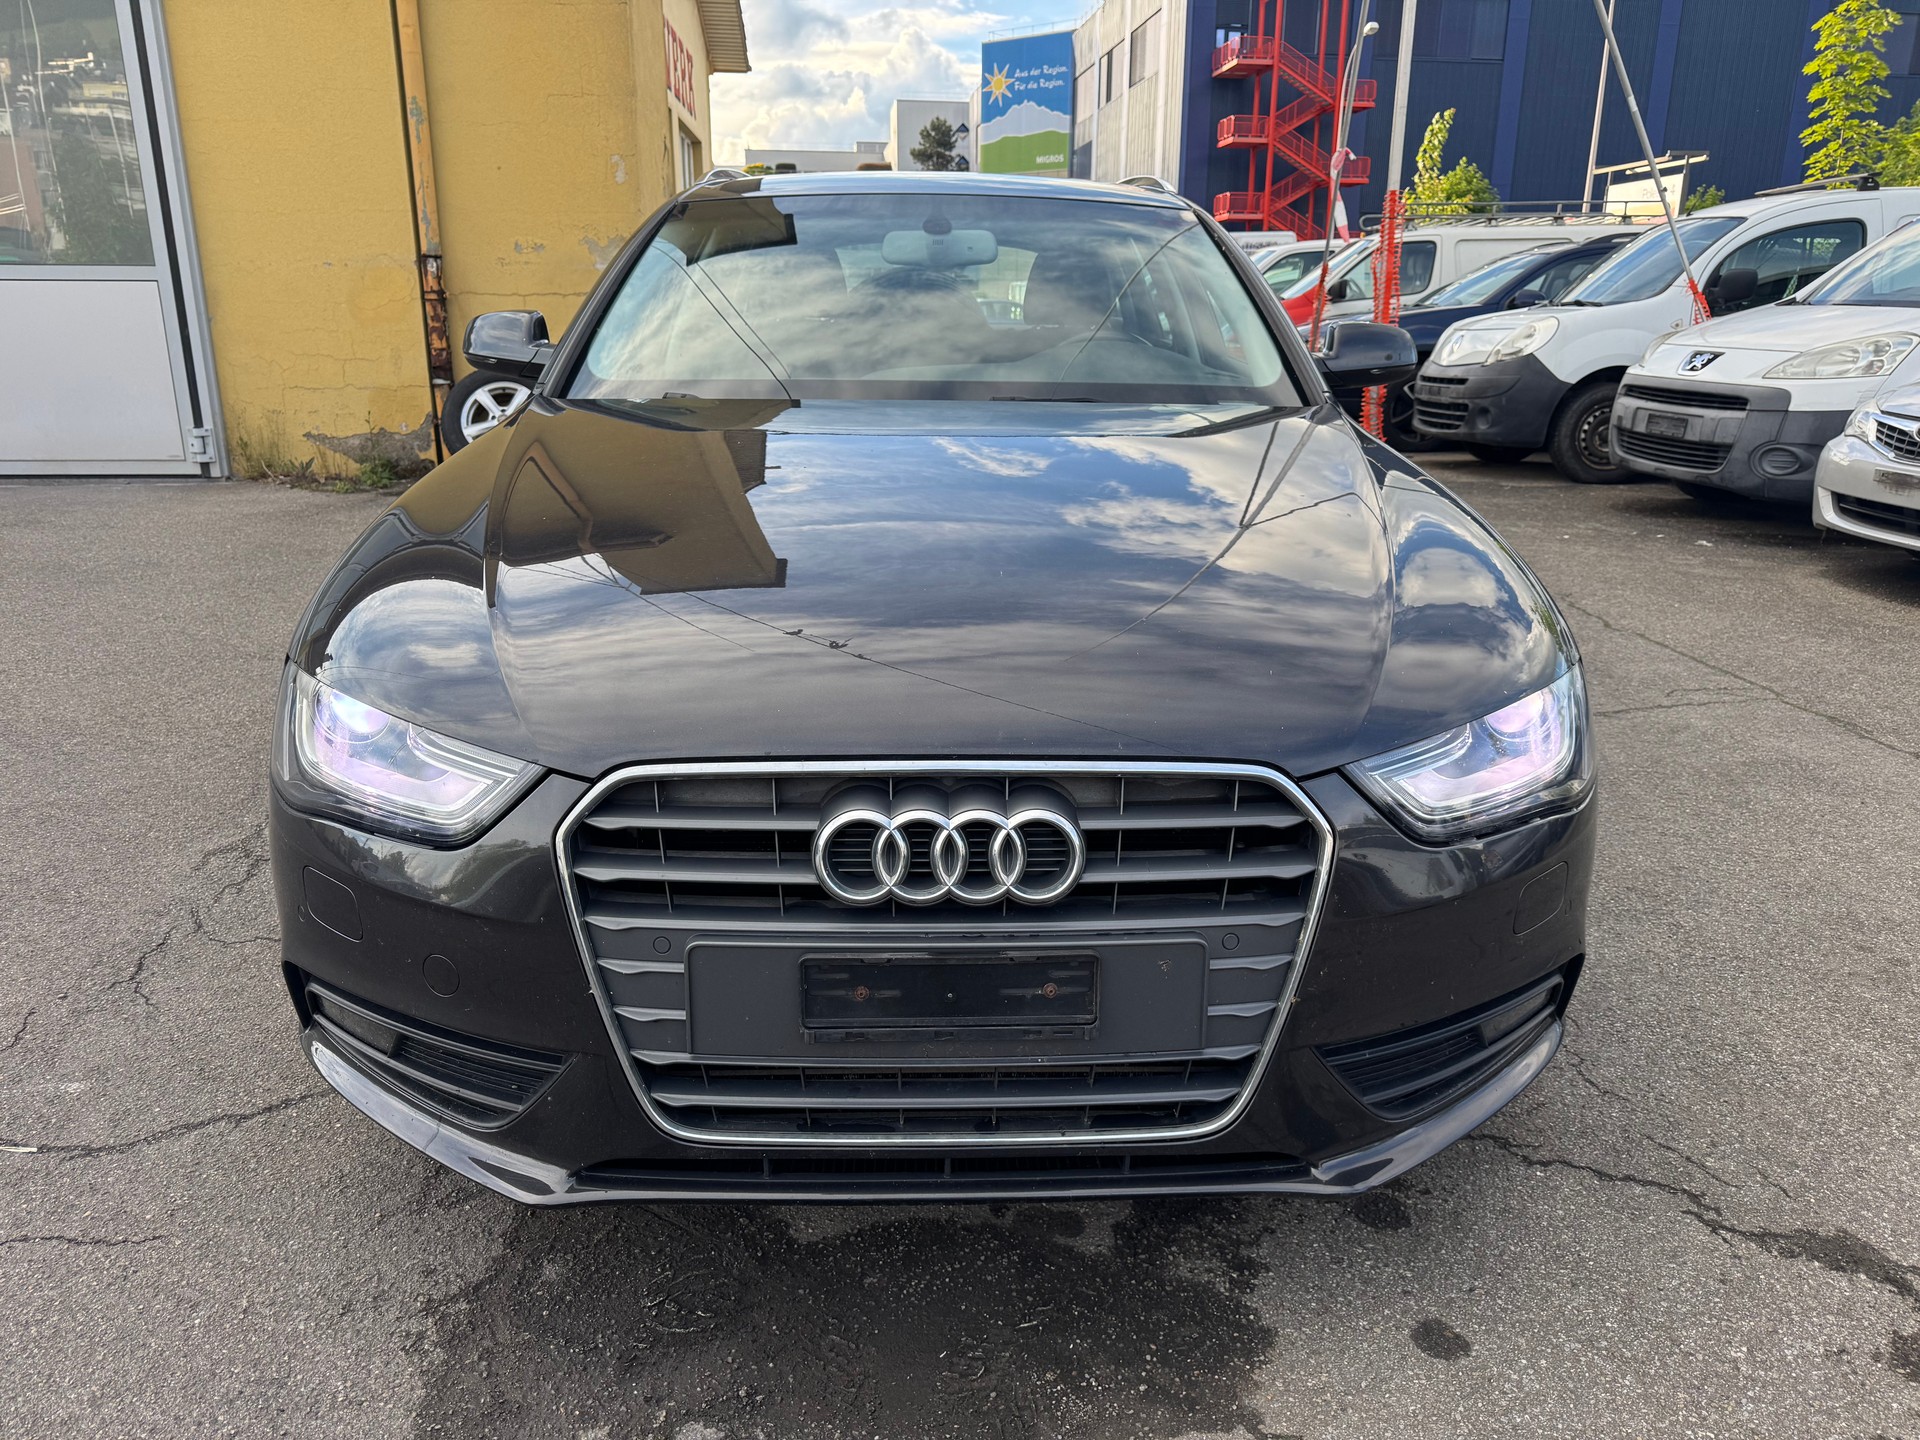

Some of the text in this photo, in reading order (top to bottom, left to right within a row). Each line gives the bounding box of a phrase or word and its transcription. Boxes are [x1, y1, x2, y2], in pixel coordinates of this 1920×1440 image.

[1014, 68, 1029, 78] Aus
[1030, 67, 1041, 76] der
[1027, 80, 1038, 89] die
[1036, 154, 1064, 164] MIGROS
